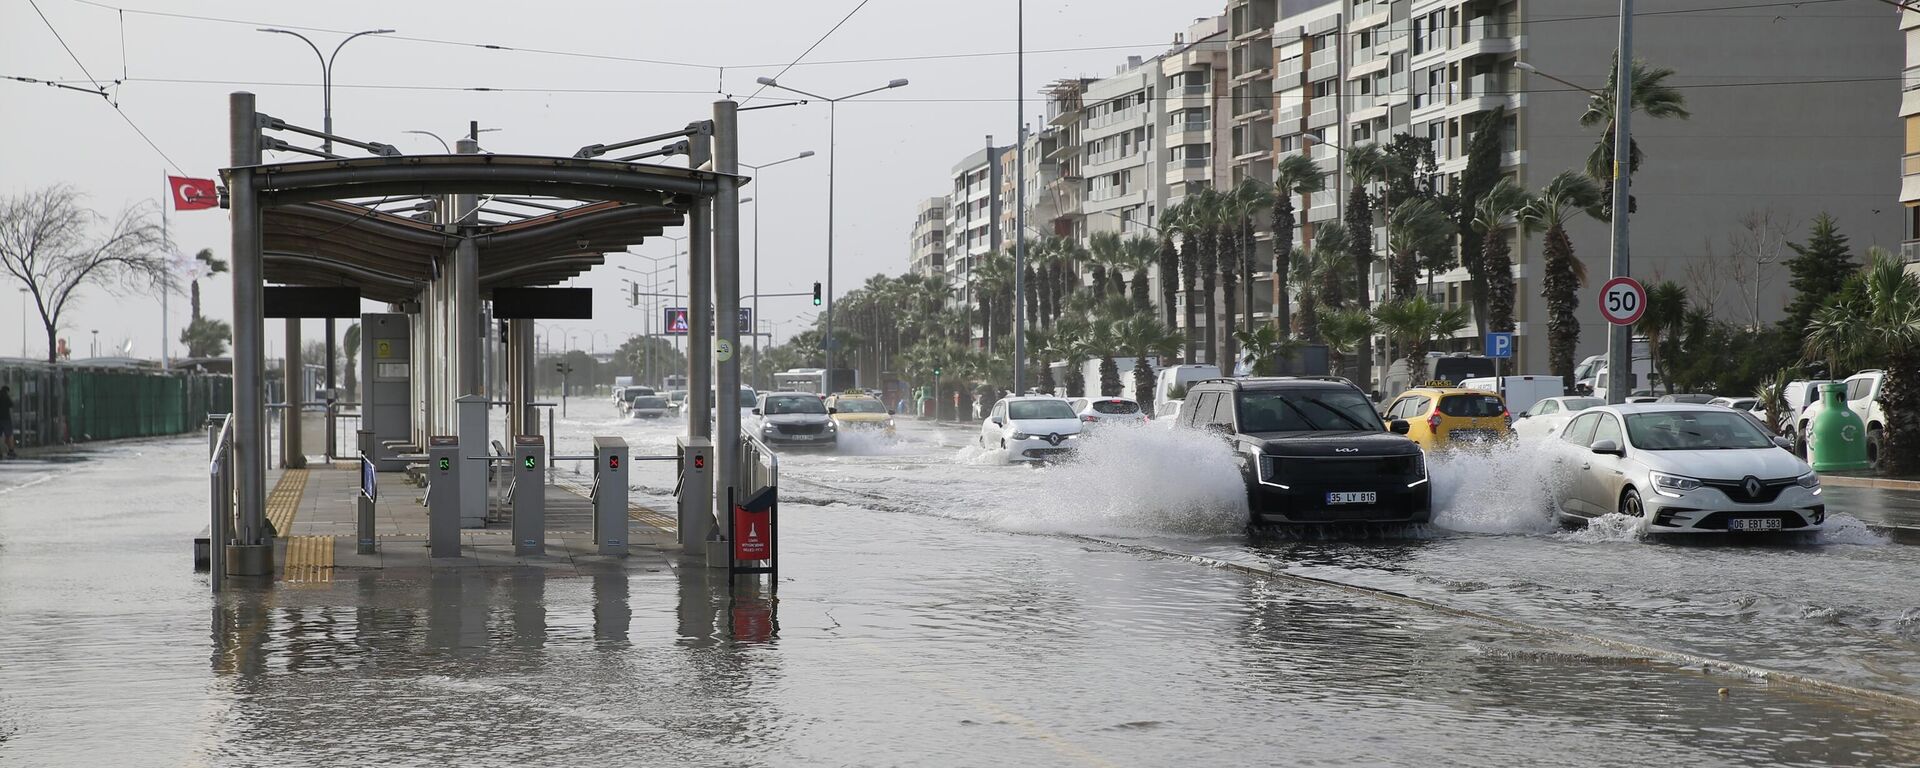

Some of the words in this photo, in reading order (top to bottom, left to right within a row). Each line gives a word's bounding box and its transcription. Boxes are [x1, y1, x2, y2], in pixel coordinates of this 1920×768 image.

[1609, 291, 1635, 311] 50
[1496, 336, 1509, 355] P
[1331, 493, 1341, 501] 35
[1346, 493, 1356, 501] LY
[1361, 492, 1375, 501] 816
[1735, 519, 1744, 528] 06
[1748, 519, 1763, 528] EBT
